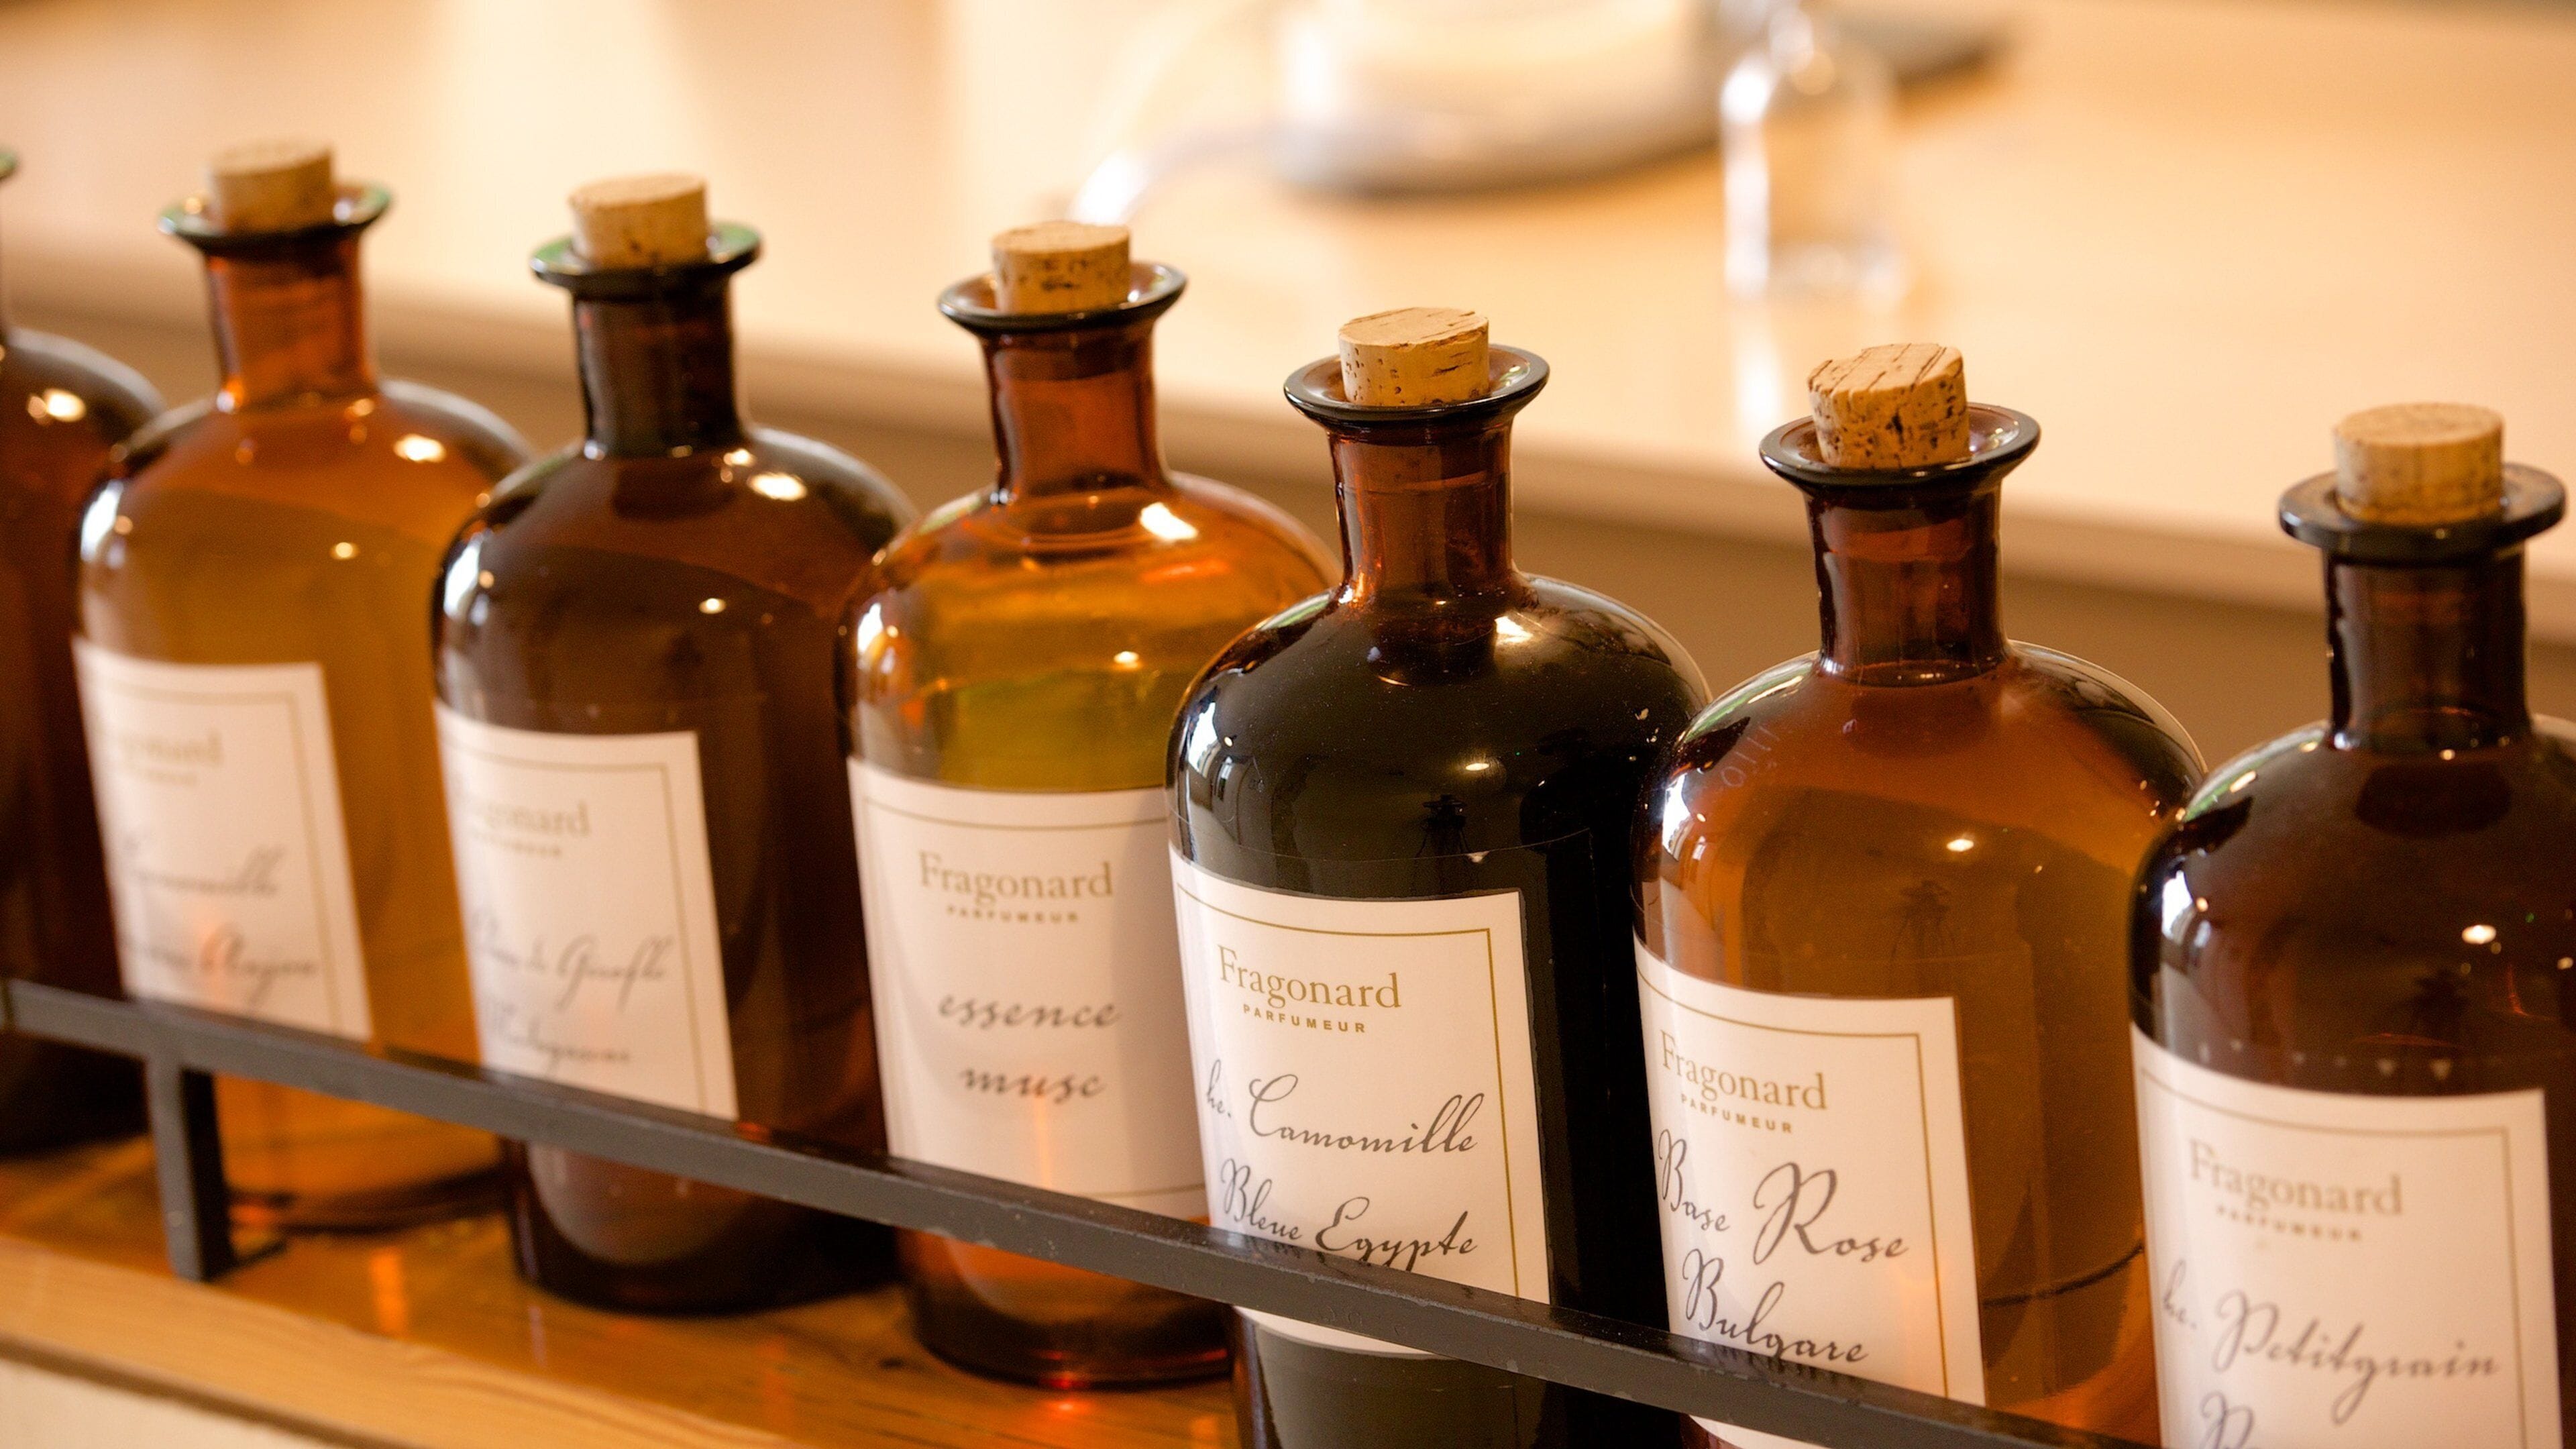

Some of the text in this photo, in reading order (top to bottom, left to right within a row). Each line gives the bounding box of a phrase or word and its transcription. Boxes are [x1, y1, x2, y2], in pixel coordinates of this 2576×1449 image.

[918, 851, 1114, 904] Fragonard
[938, 996, 1123, 1028] essence
[1217, 945, 1401, 1008] Fragonard
[1243, 1004, 1366, 1033] PARFUMEUR
[959, 1067, 1106, 1104] musc
[1660, 1030, 1827, 1111] Fragonard
[1249, 1074, 1485, 1154] Camomille
[1680, 1095, 1793, 1134] PARFUMEUR
[1658, 1129, 1909, 1266] Base Rose
[2190, 1138, 2403, 1216] Fragonard
[1316, 1197, 1478, 1271] Egypte
[1682, 1248, 1869, 1363] Bulgare
[2214, 1289, 2498, 1426] Petitgrain
